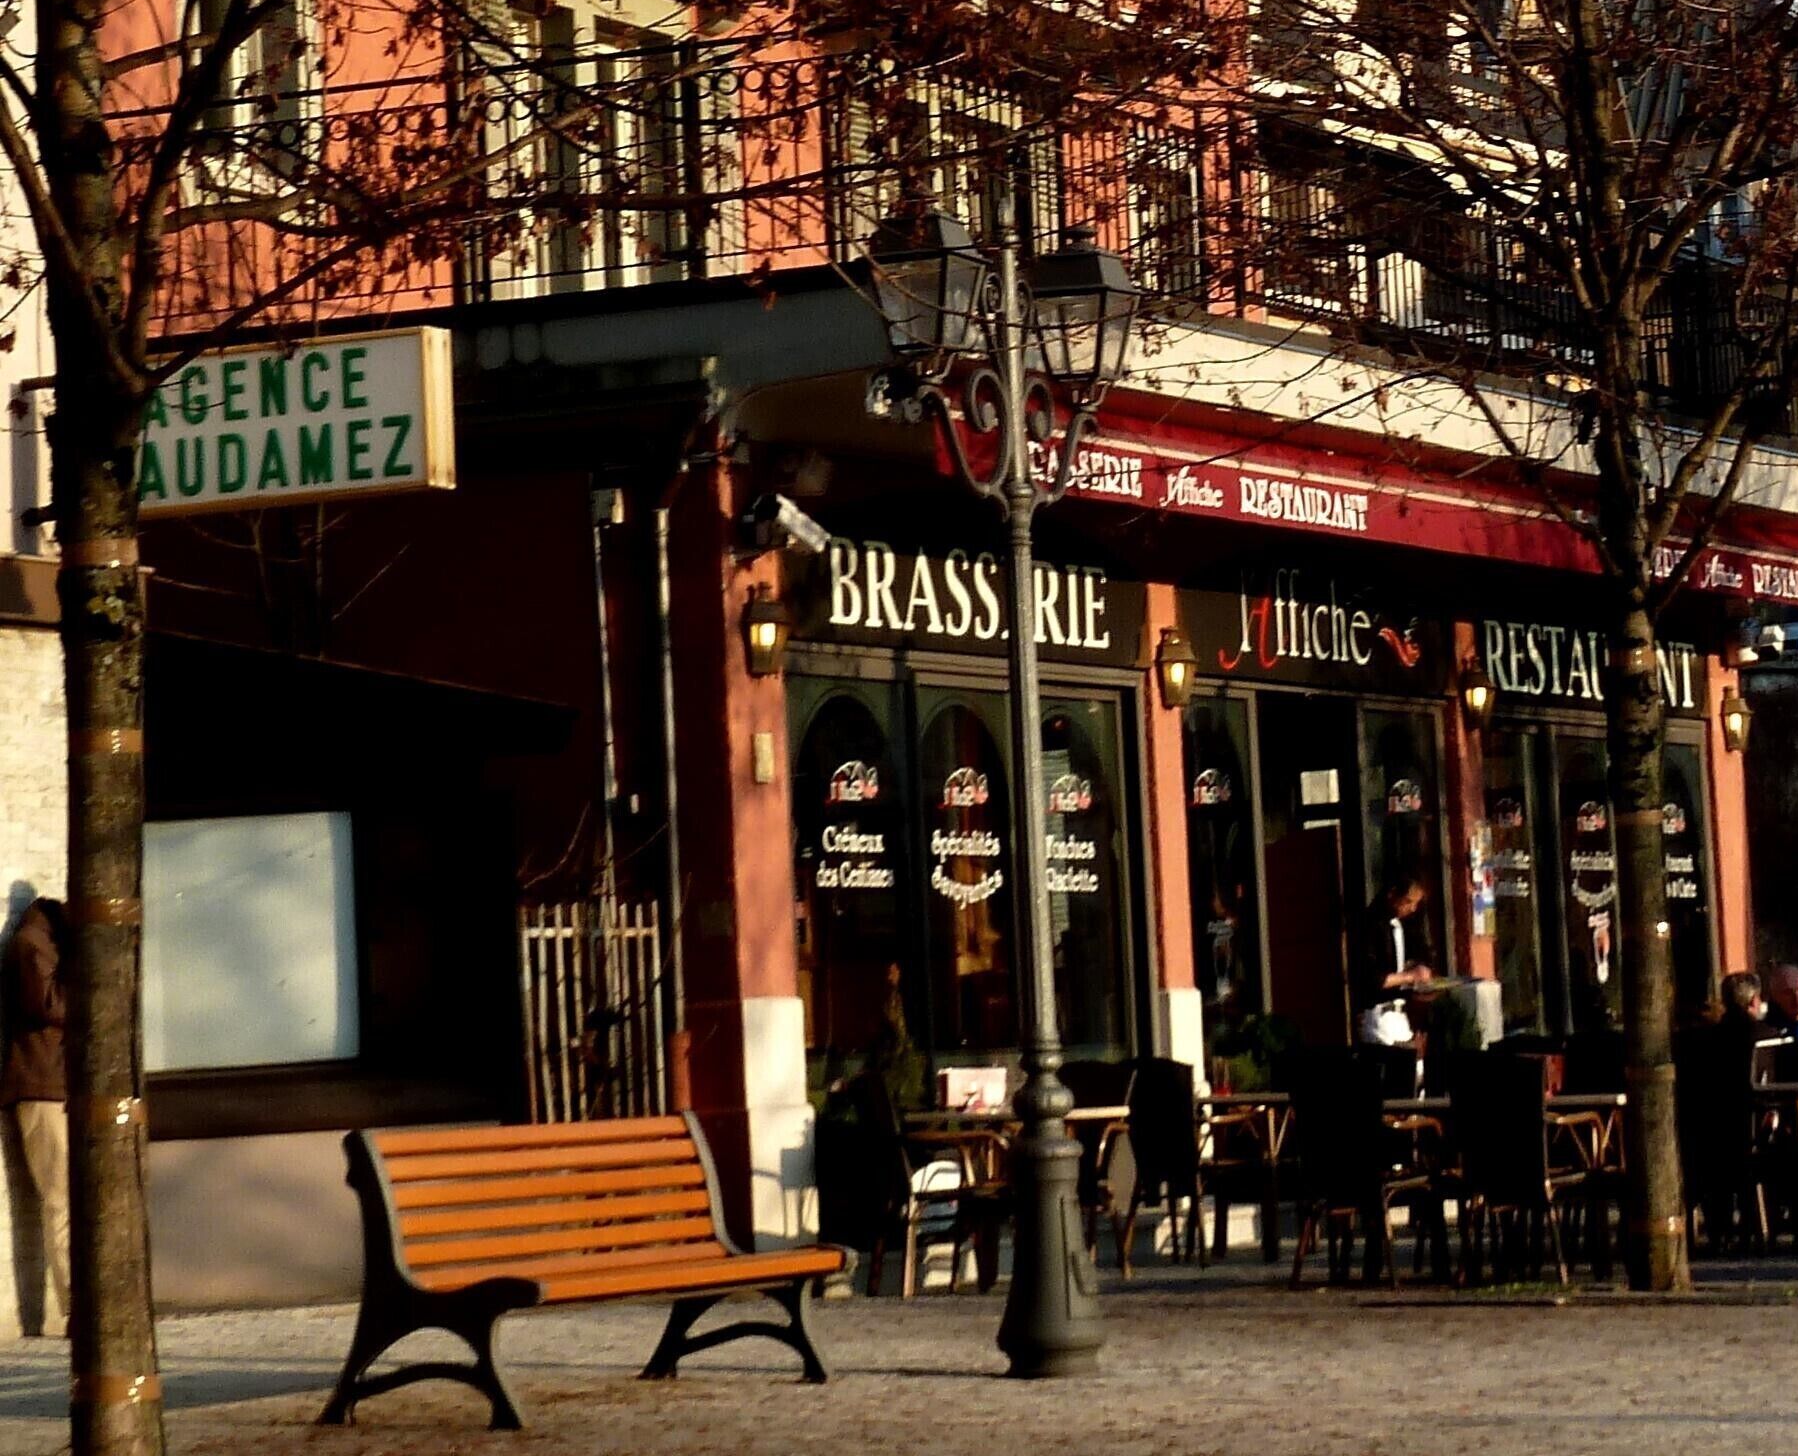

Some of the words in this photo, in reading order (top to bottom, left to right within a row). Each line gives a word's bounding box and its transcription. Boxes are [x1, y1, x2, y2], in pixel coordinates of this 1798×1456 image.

[139, 348, 368, 429] AGENCE
[1027, 441, 1143, 498] RASERIE
[1239, 476, 1368, 531] RESTAURANT
[829, 537, 1110, 649] BRASSRIE
[1483, 619, 1697, 710] RESTAUNT
